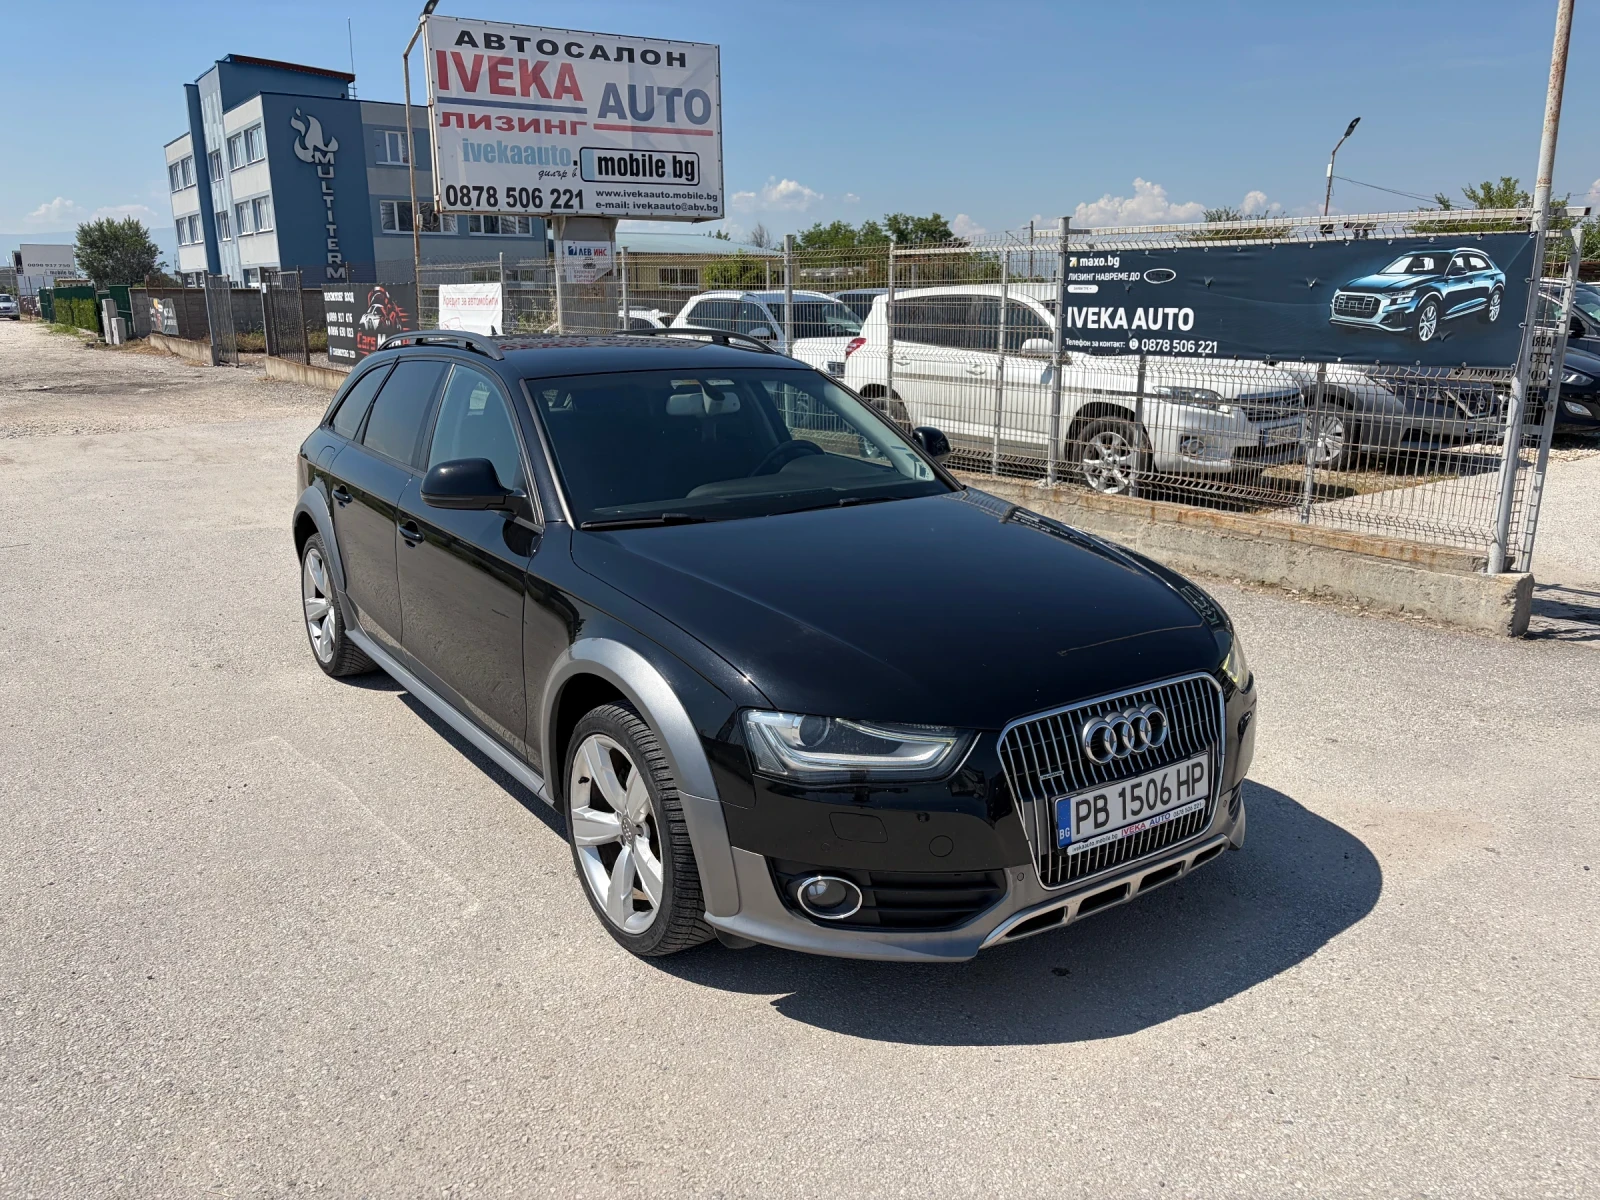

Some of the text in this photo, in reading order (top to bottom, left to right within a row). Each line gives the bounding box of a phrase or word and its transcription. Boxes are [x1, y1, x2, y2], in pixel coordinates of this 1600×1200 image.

[454, 30, 687, 68] АВТОСАЛОН
[436, 50, 712, 125] IVEKA AUTO
[439, 111, 588, 136] ЛИЗИНГ
[597, 153, 696, 182] mobile.bg
[445, 184, 584, 210] 0878 506 221
[595, 190, 718, 202] www.ivekaauto.mobile.bg
[314, 151, 346, 279] MULTITERM
[595, 201, 718, 213] e-mail: ivekaauto@abv.bg
[593, 248, 607, 257] ИНС
[1080, 255, 1120, 268] maxo.bg
[1068, 273, 1095, 281] ЛИЗИНГ
[1129, 272, 1141, 281] ДО
[1067, 306, 1195, 331] IVEKA AUTO
[357, 331, 376, 350] Cars
[1066, 338, 1126, 348] Телефон за контакт:
[1141, 338, 1218, 354] 0878 506 221
[1075, 762, 1205, 835] PB 1506 HP
[1059, 828, 1071, 840] BG
[1121, 823, 1147, 837] IVEKA
[1149, 813, 1171, 826] AUTO
